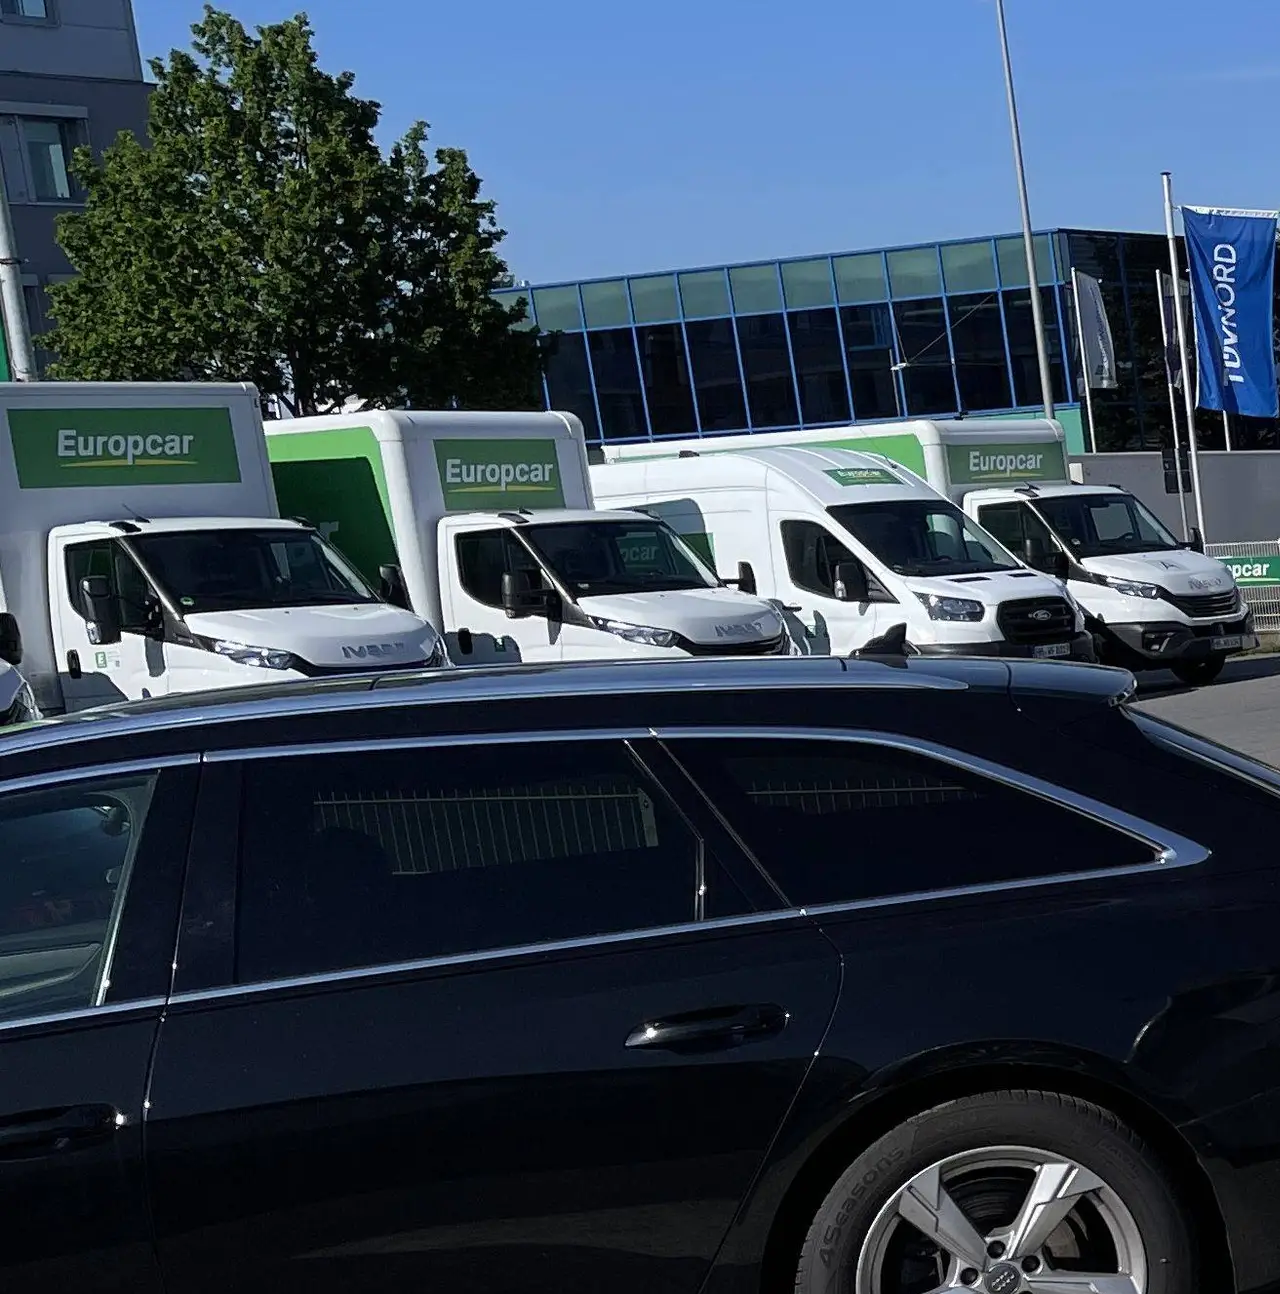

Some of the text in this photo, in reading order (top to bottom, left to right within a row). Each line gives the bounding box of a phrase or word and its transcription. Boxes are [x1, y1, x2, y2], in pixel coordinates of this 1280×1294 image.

[1212, 243, 1237, 328] NORD
[57, 429, 194, 464] Europcar
[445, 459, 554, 489] Europcar
[969, 451, 1043, 477] Europcar
